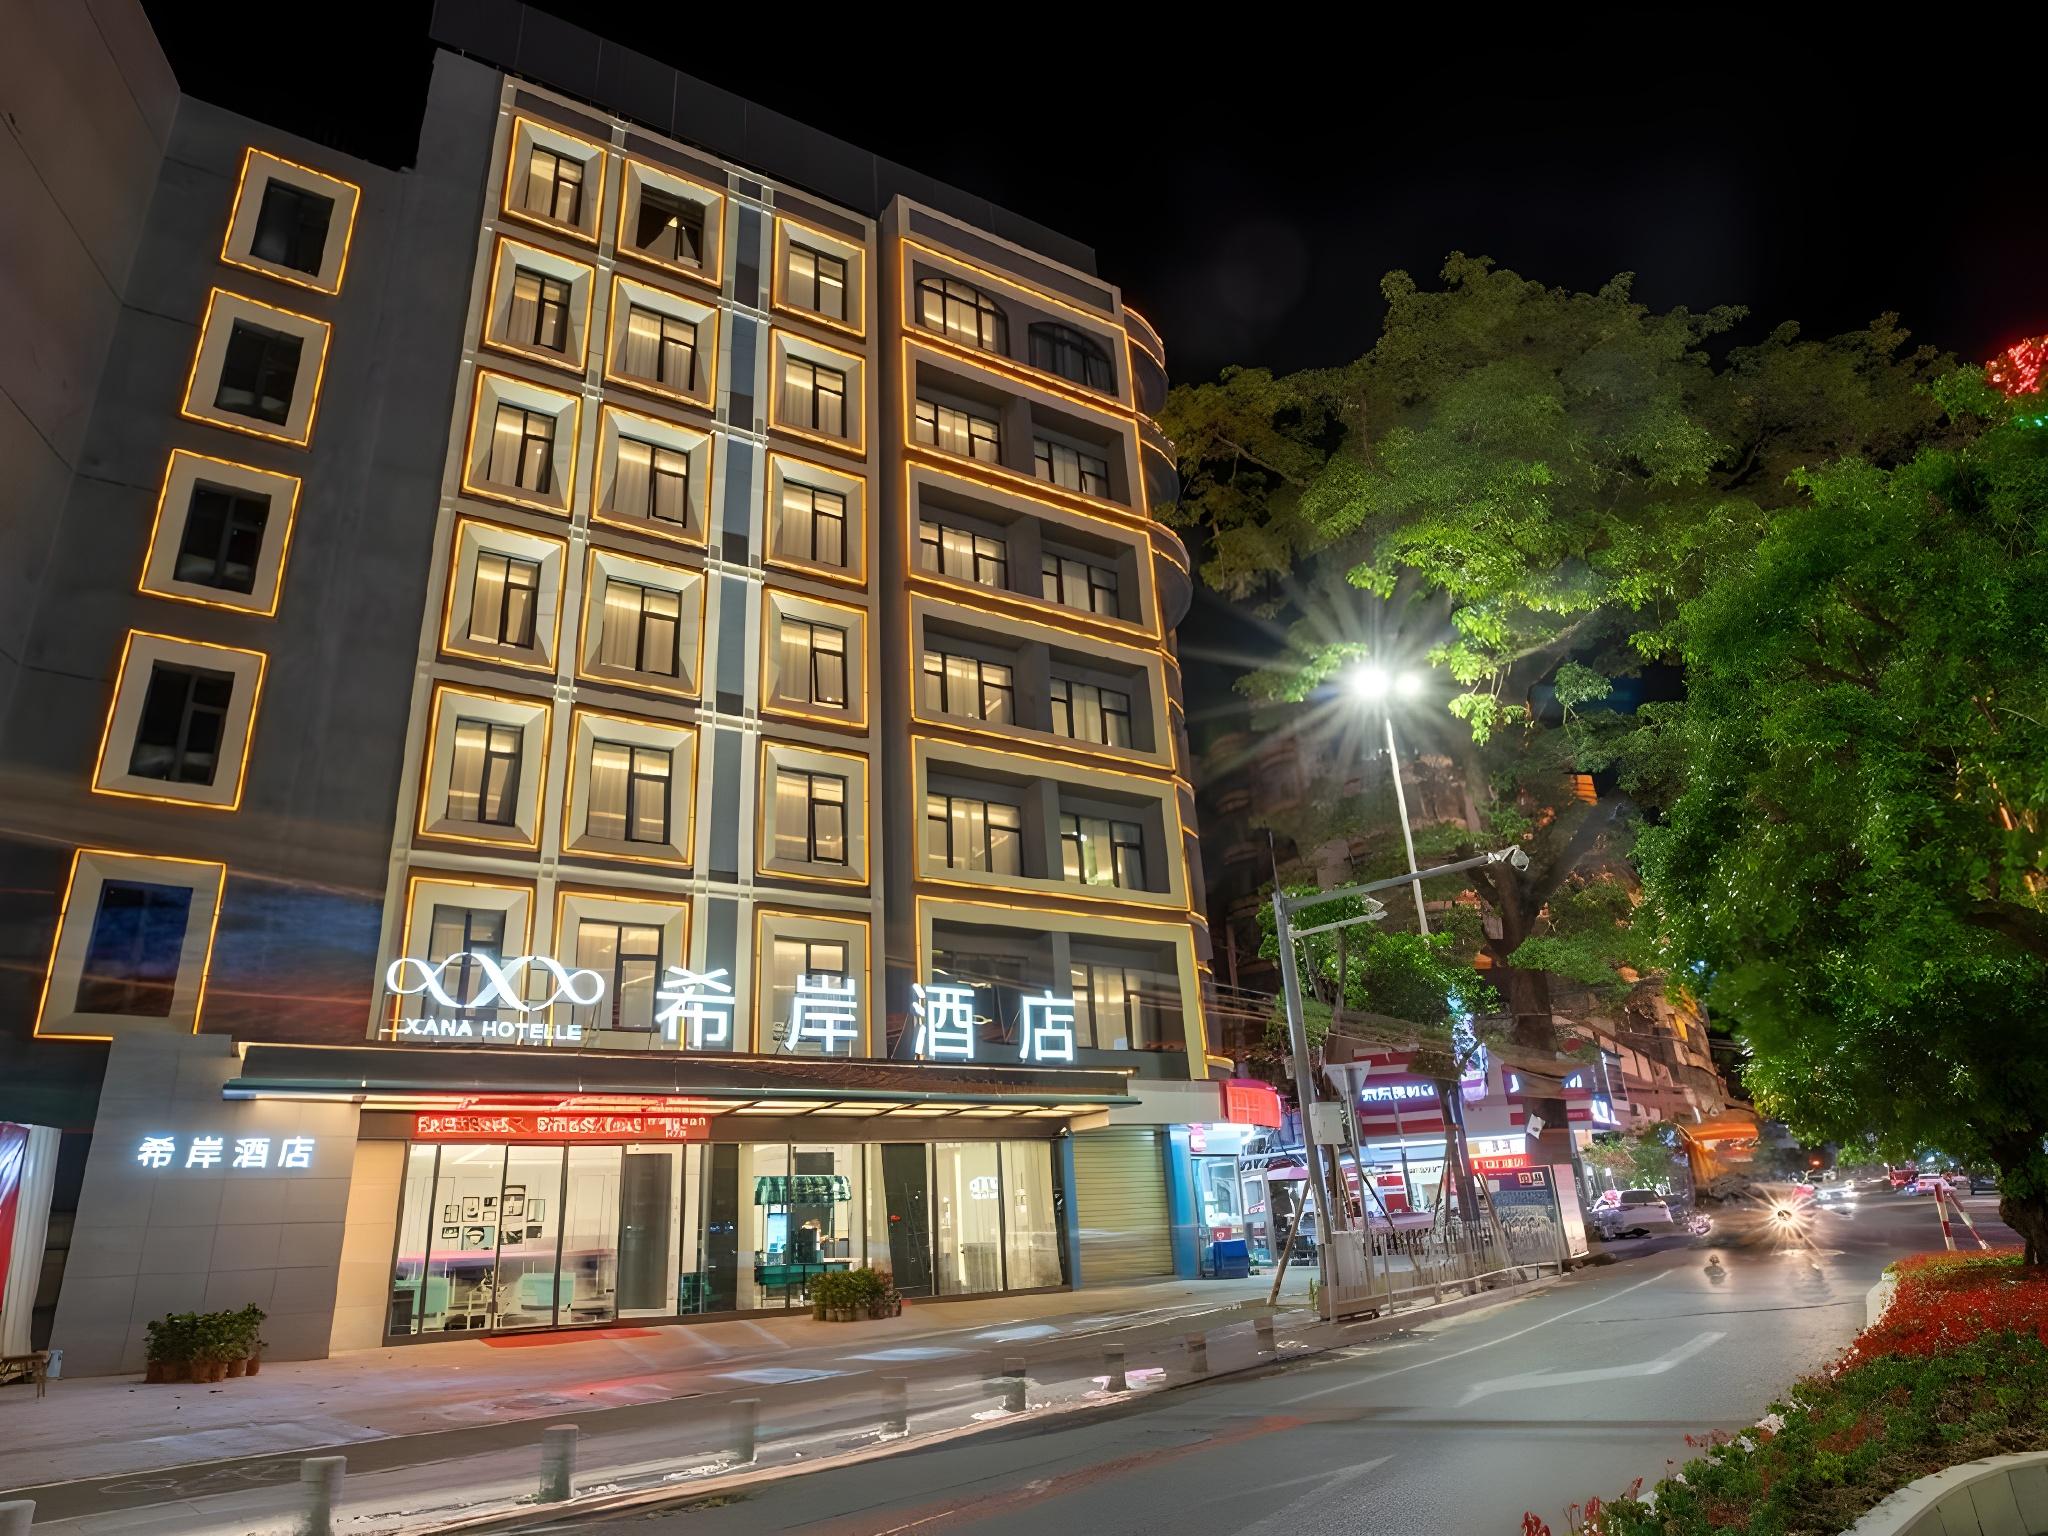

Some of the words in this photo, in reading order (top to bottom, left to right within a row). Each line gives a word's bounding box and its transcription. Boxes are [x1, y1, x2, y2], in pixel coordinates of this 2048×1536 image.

[656, 965, 1077, 1062] 希岸酒店
[482, 1020, 582, 1040] HOTELLE
[137, 1136, 315, 1168] 希岸酒店
